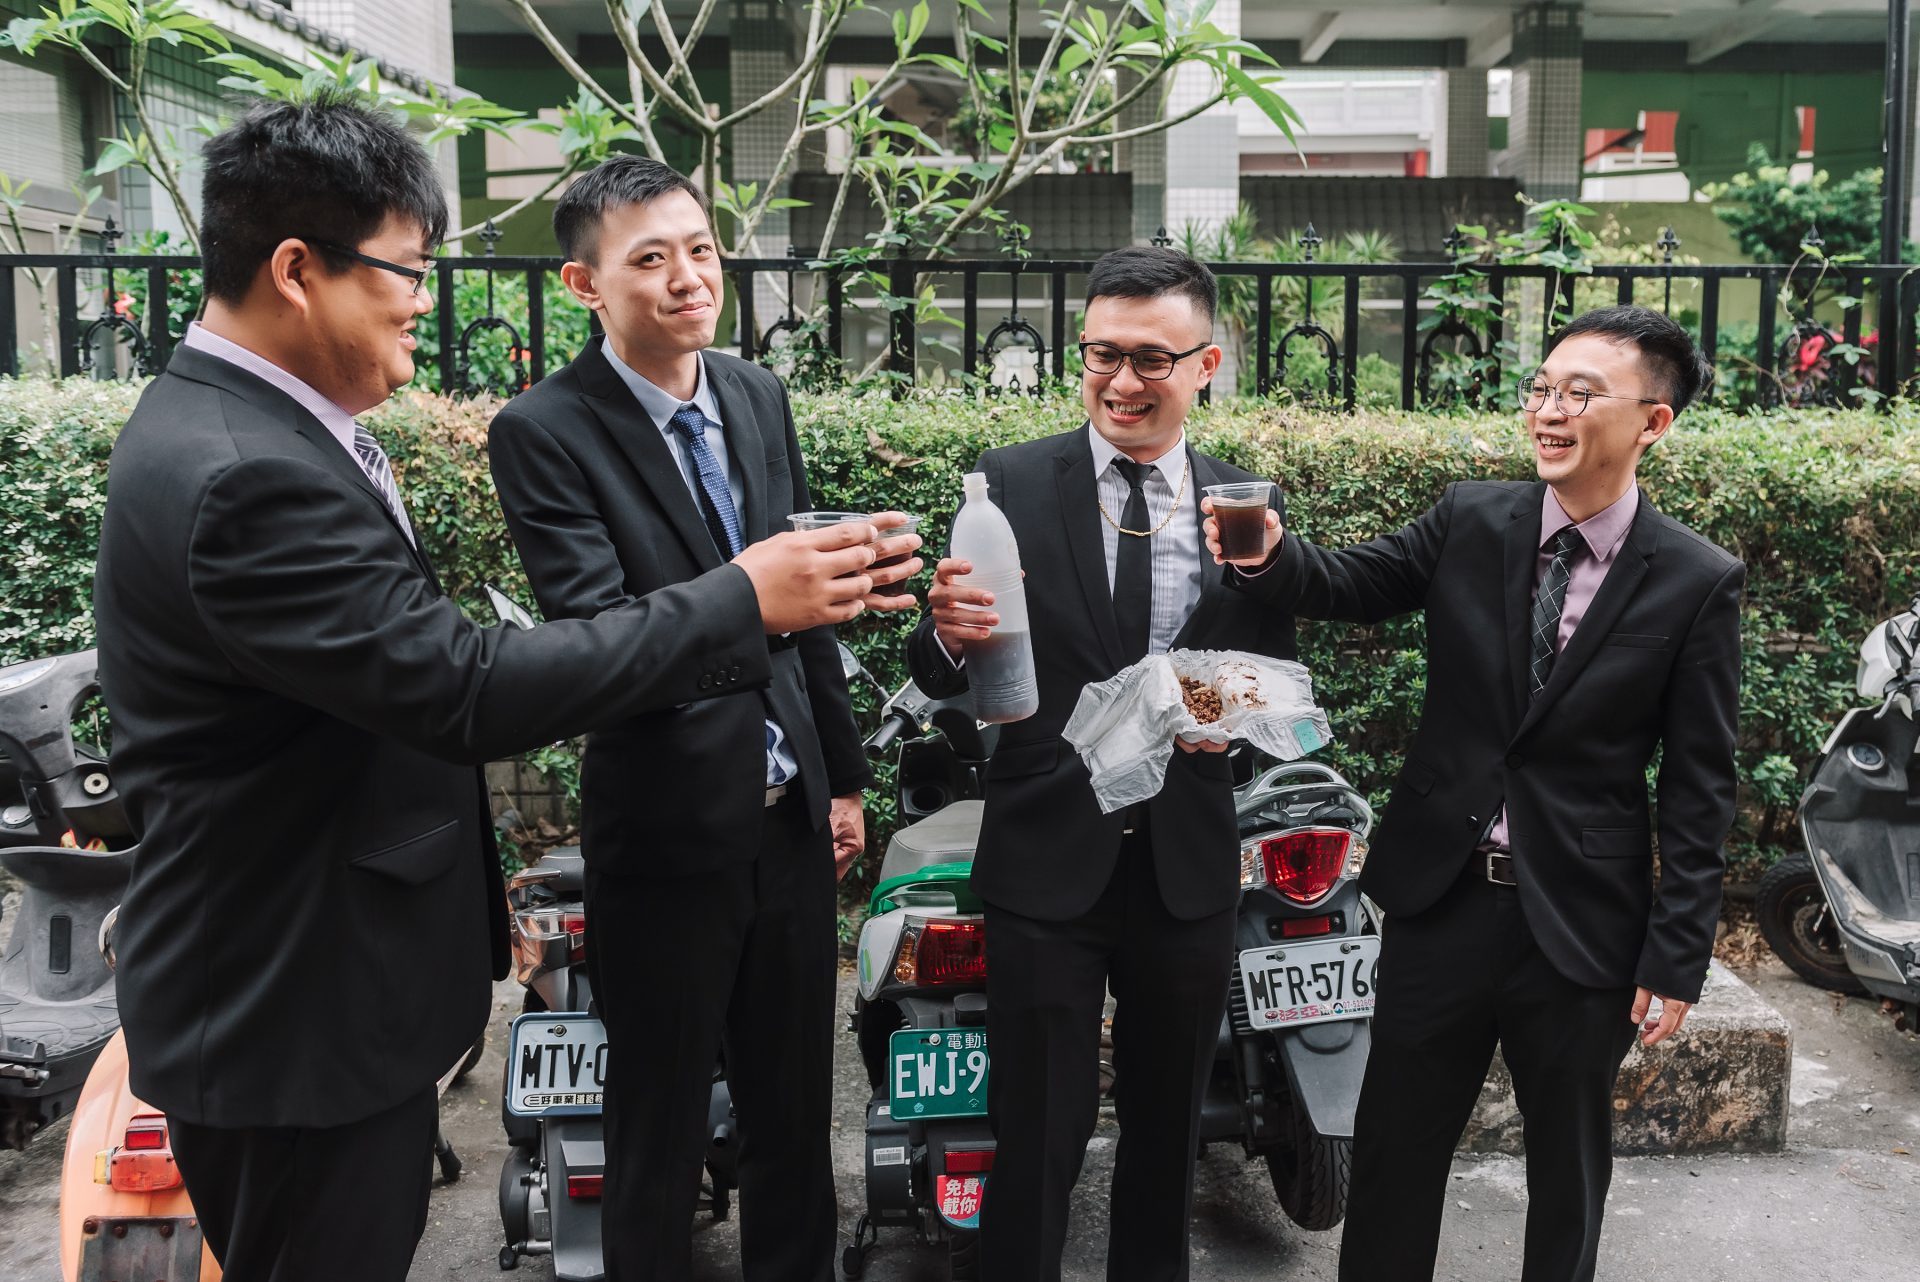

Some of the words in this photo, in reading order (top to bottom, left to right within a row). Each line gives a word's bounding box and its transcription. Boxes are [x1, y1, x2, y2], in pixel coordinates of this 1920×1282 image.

[946, 1033, 987, 1050] 電動
[895, 1050, 990, 1099] EWJ-9
[944, 1177, 980, 1197] 免費
[942, 1196, 978, 1216] 載你
